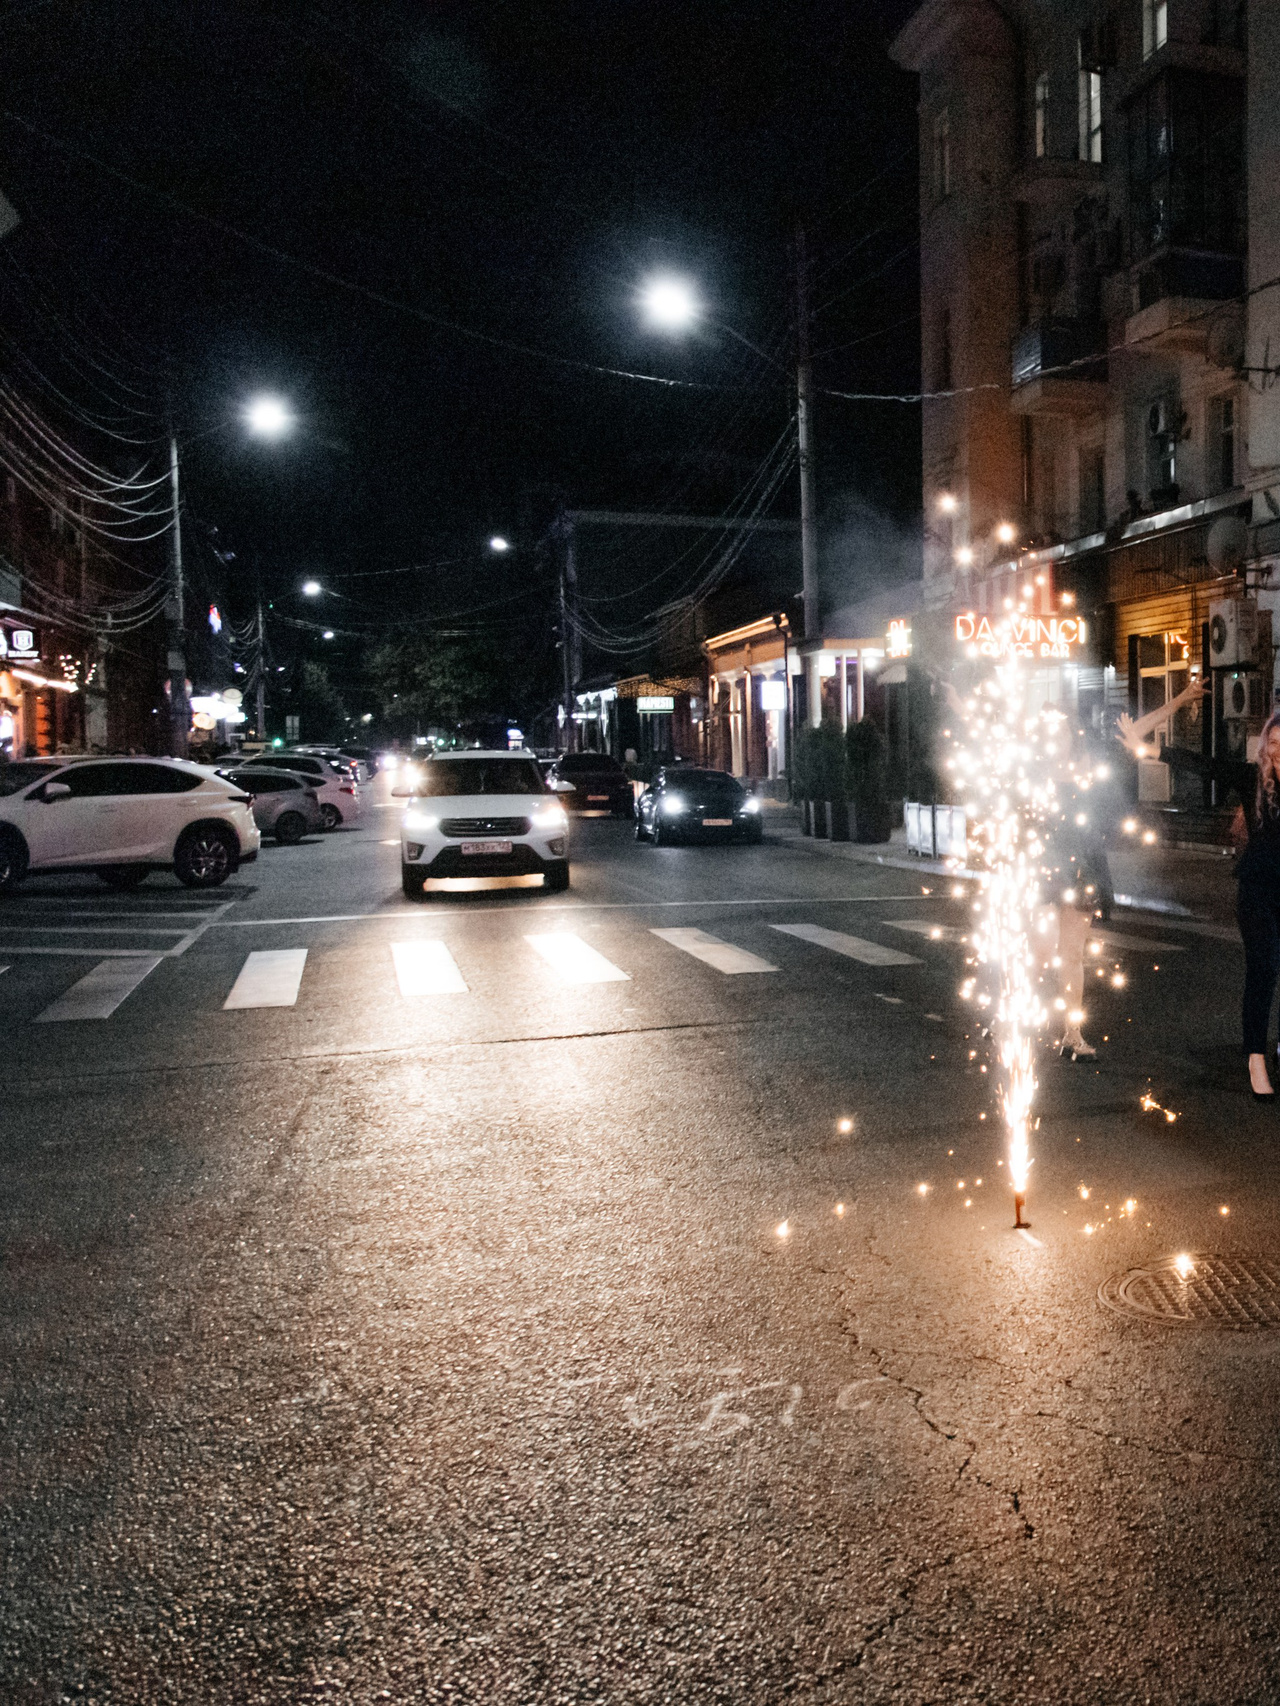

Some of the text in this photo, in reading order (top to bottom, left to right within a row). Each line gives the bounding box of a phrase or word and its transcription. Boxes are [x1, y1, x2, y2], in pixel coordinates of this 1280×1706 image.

[956, 615, 1085, 643] DA VINCI
[972, 642, 1070, 658] OUNGE BAR
